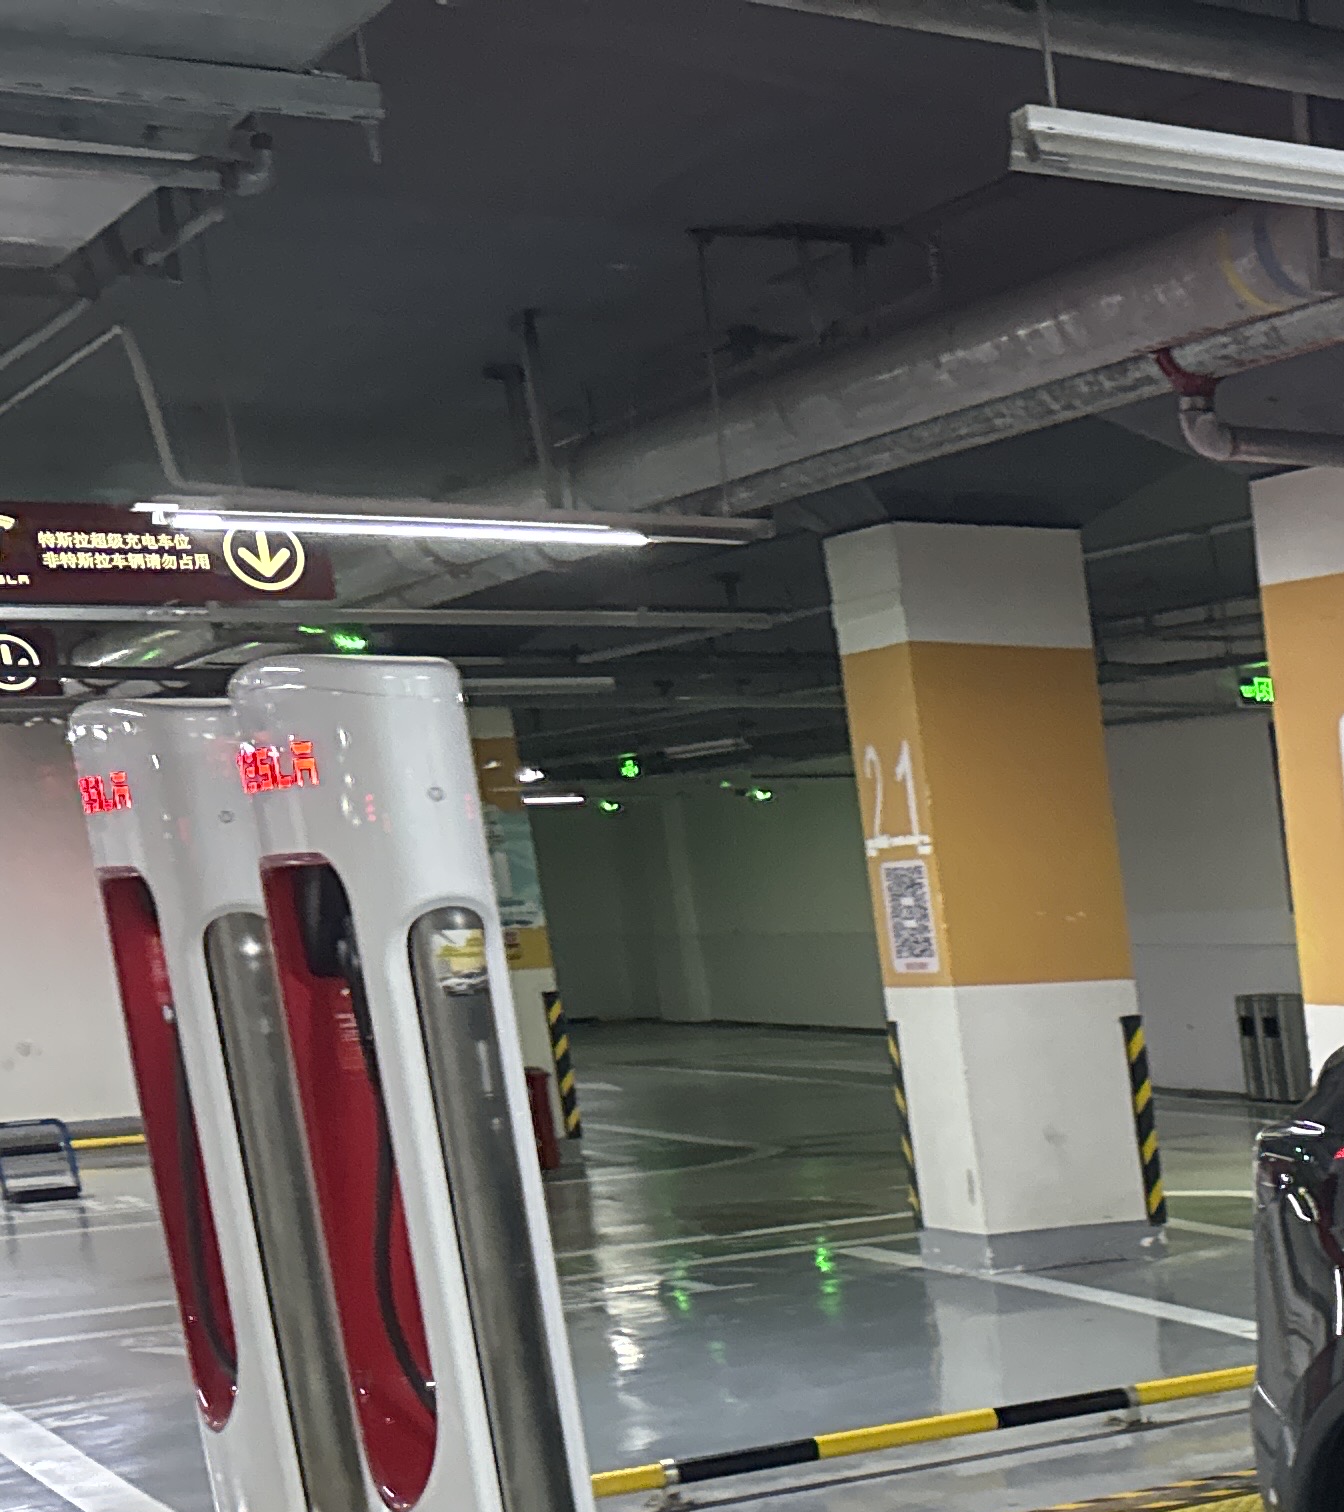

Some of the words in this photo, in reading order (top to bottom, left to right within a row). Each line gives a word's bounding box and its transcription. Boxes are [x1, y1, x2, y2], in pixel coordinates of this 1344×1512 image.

[38, 531, 192, 550] 特斯拉超级充电车位
[42, 550, 210, 570] 非特斯拉车辆请勿占用
[864, 740, 919, 839] 21
